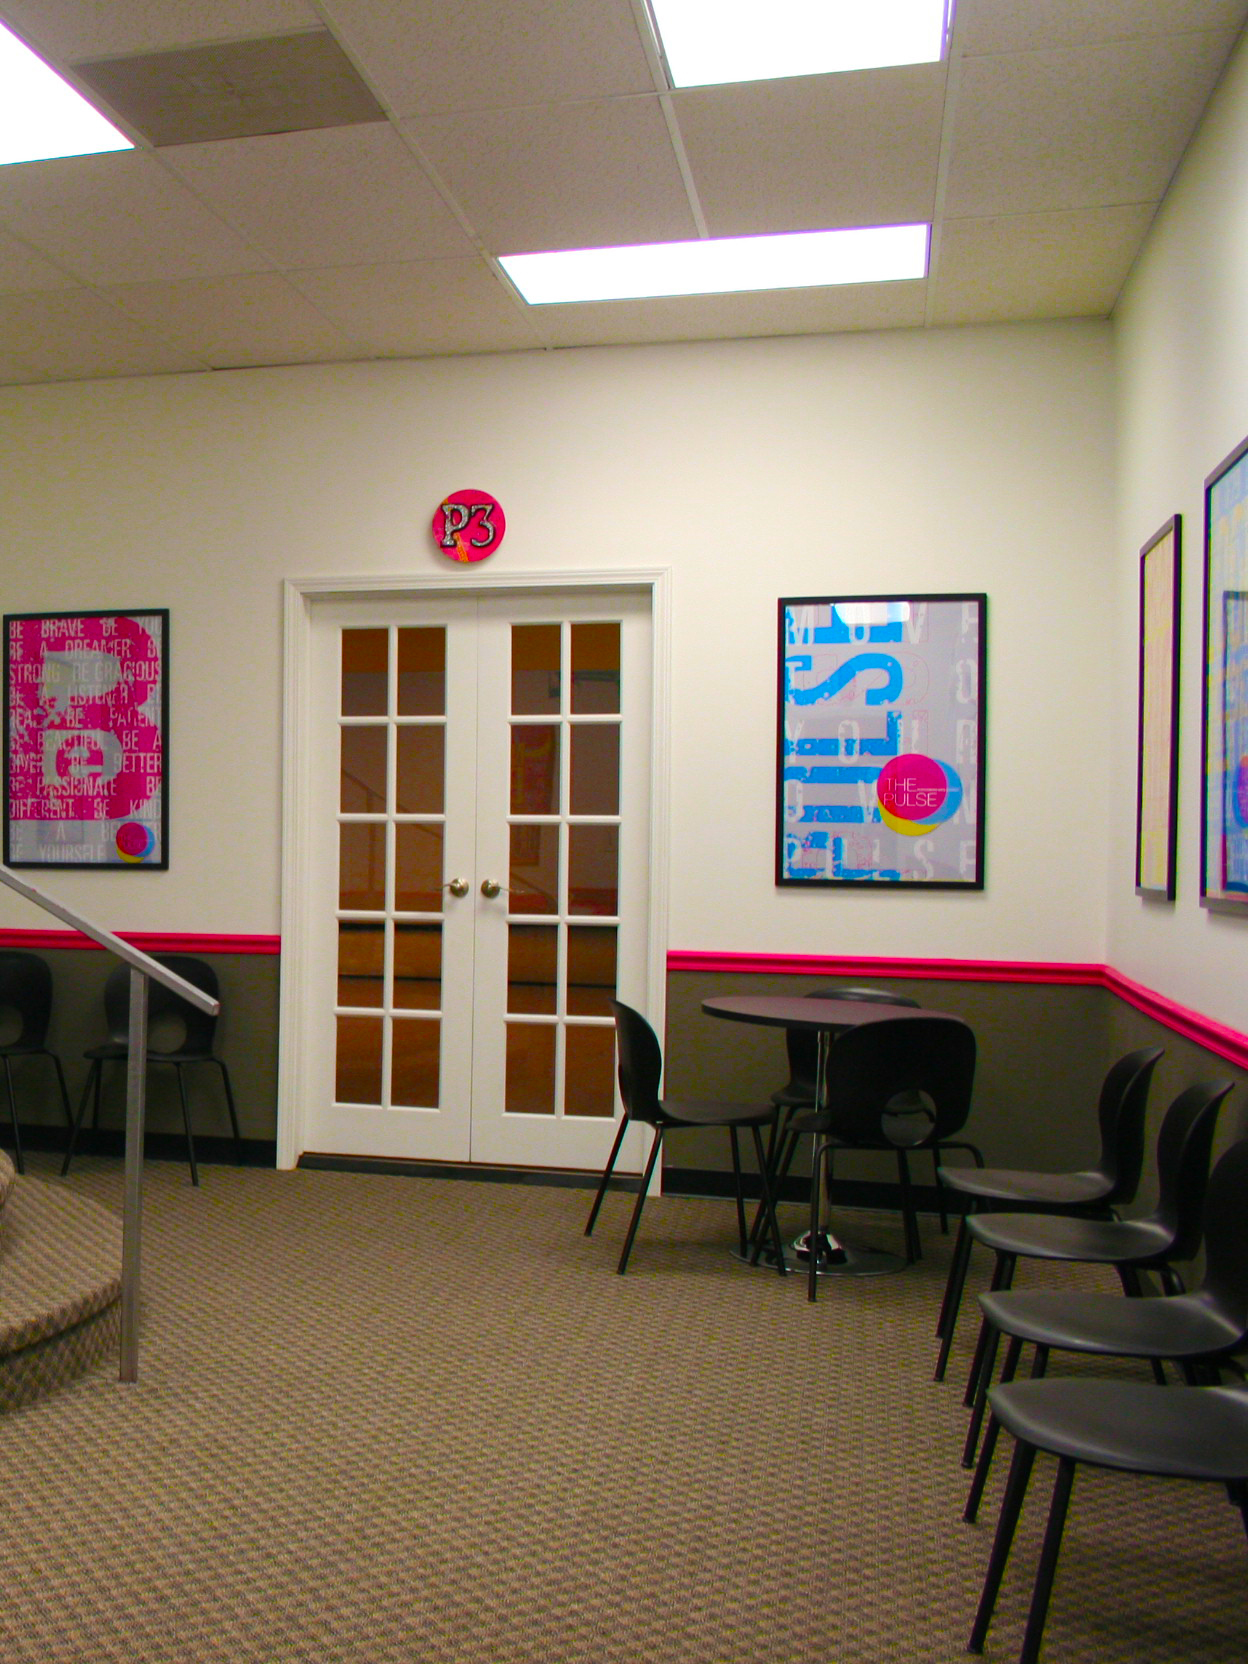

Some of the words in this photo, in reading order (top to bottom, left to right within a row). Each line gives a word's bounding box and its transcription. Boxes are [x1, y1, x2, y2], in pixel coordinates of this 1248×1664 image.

[440, 503, 495, 547] P3
[40, 618, 85, 638] BRAVE
[66, 707, 84, 728] BE
[122, 729, 140, 751] BE
[887, 777, 917, 792] THE
[883, 792, 938, 807] PULSE
